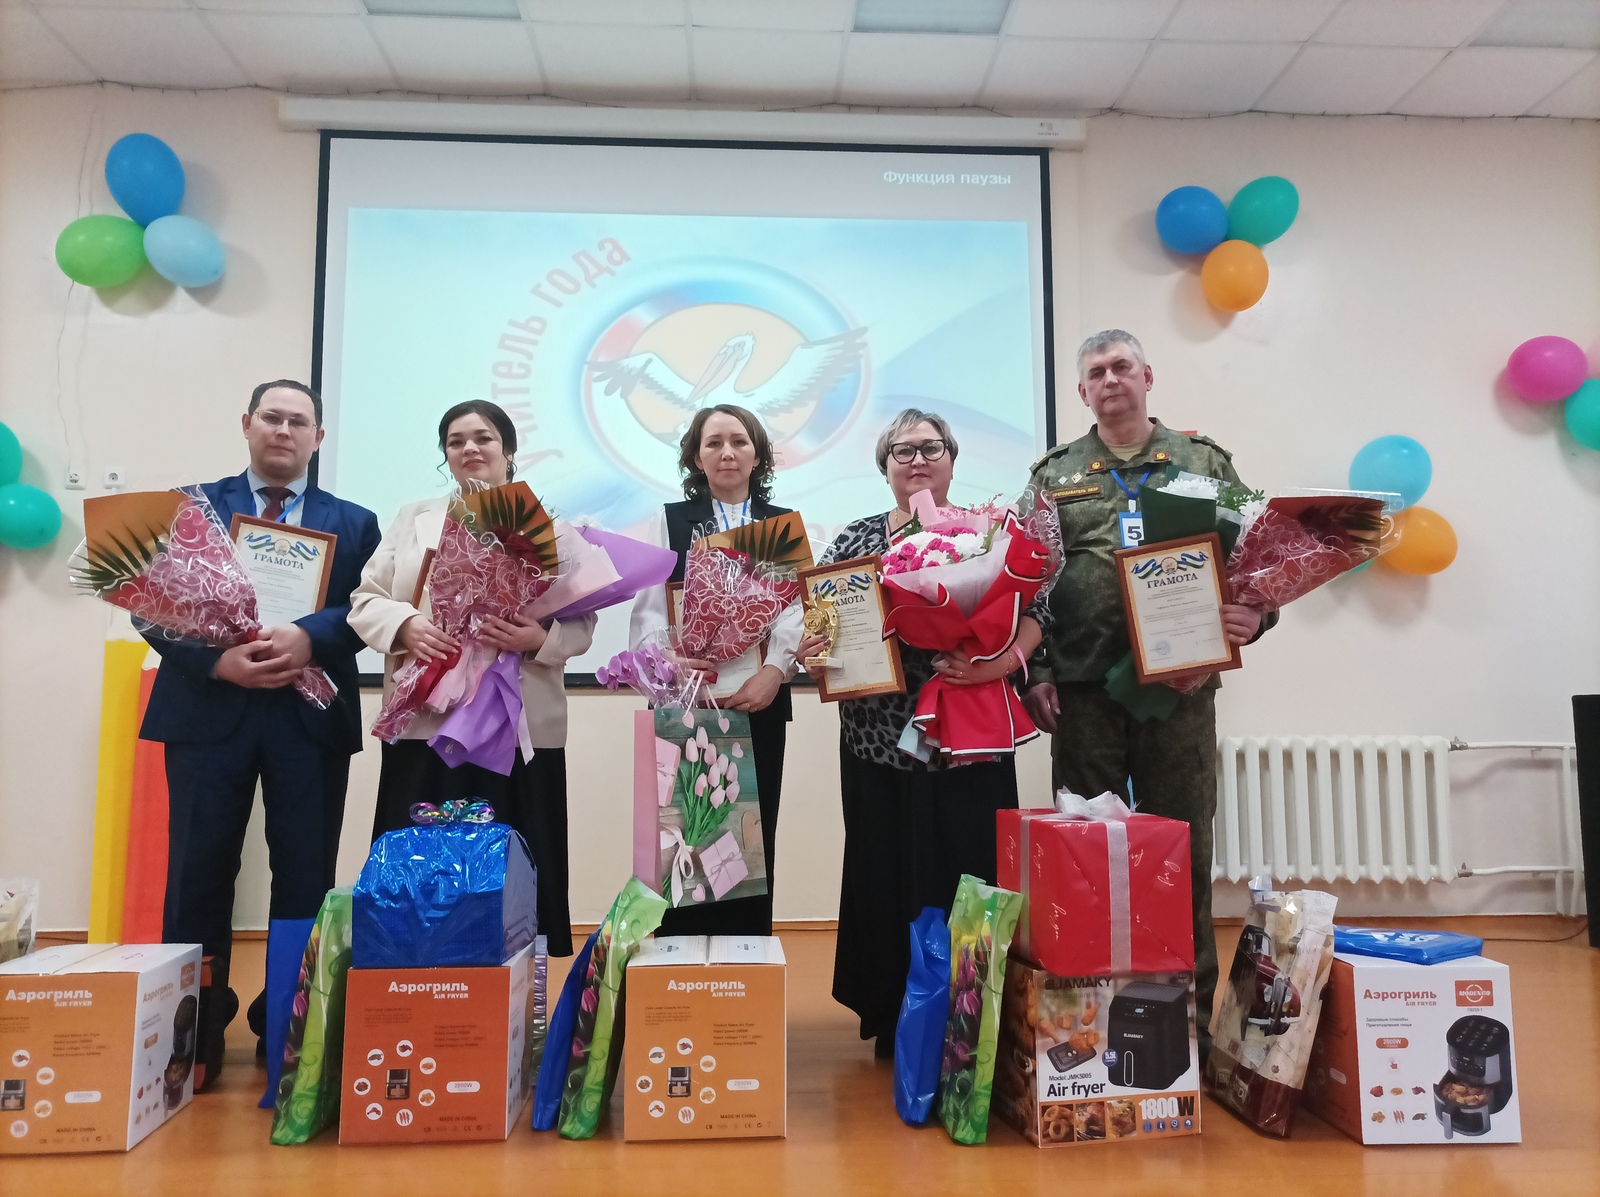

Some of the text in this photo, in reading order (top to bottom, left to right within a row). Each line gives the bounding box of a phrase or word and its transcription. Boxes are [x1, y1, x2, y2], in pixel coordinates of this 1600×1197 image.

[883, 170, 1012, 186] Функция паузы
[530, 237, 632, 308] года
[1127, 526, 1142, 541] 5
[254, 552, 304, 570] ГРАМОТА
[1146, 572, 1198, 589] ГРАМОТА
[833, 594, 866, 608] АМОТА
[388, 982, 468, 994] Аэрогриль
[667, 980, 745, 992] Аэрогриль
[6, 990, 92, 1003] Аэрогриль
[1363, 989, 1437, 1002] Аэрогриль
[1047, 1082, 1106, 1098] Air fryer
[1139, 1096, 1195, 1120] 1800W
